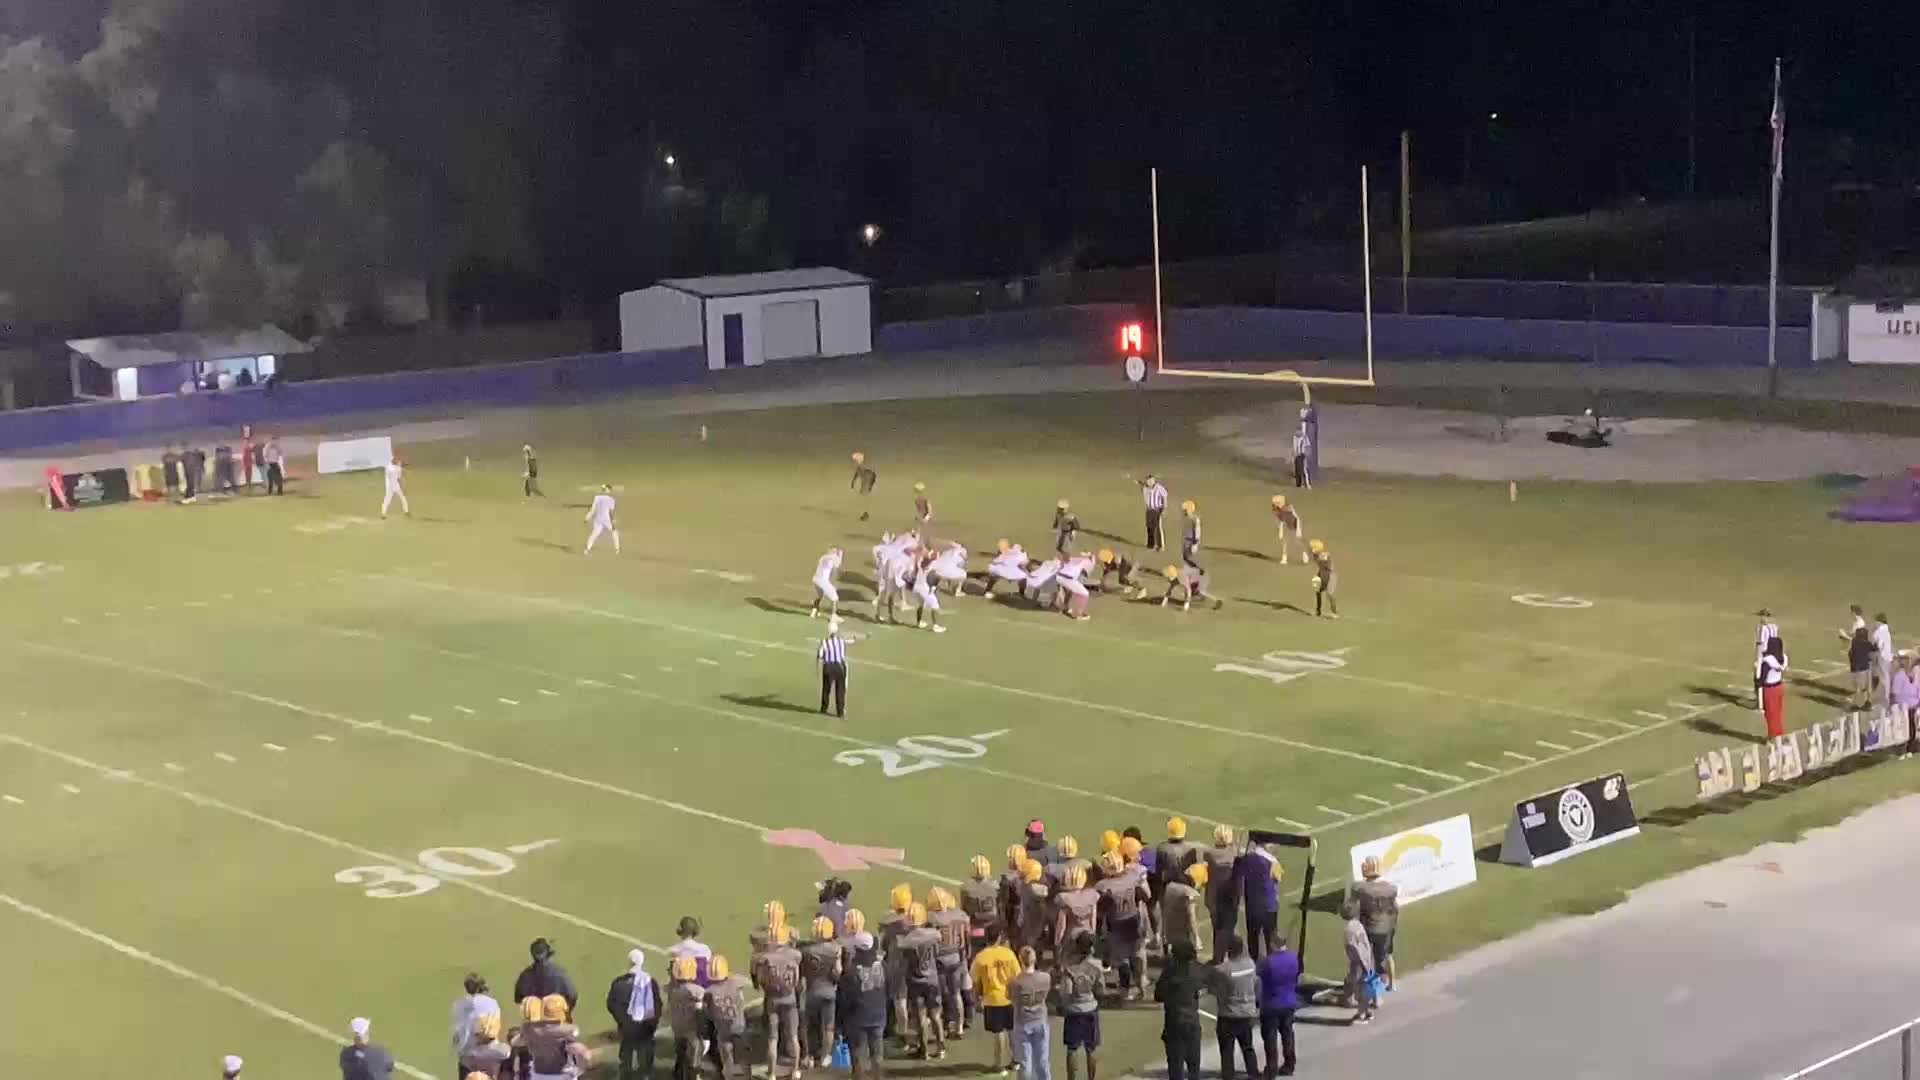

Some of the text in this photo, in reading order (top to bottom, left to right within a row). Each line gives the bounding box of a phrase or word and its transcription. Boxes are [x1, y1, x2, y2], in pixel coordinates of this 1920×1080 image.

[1122, 324, 1142, 351] 19
[1213, 649, 1347, 684] 10
[833, 734, 987, 777] 20
[334, 846, 515, 898] 30
